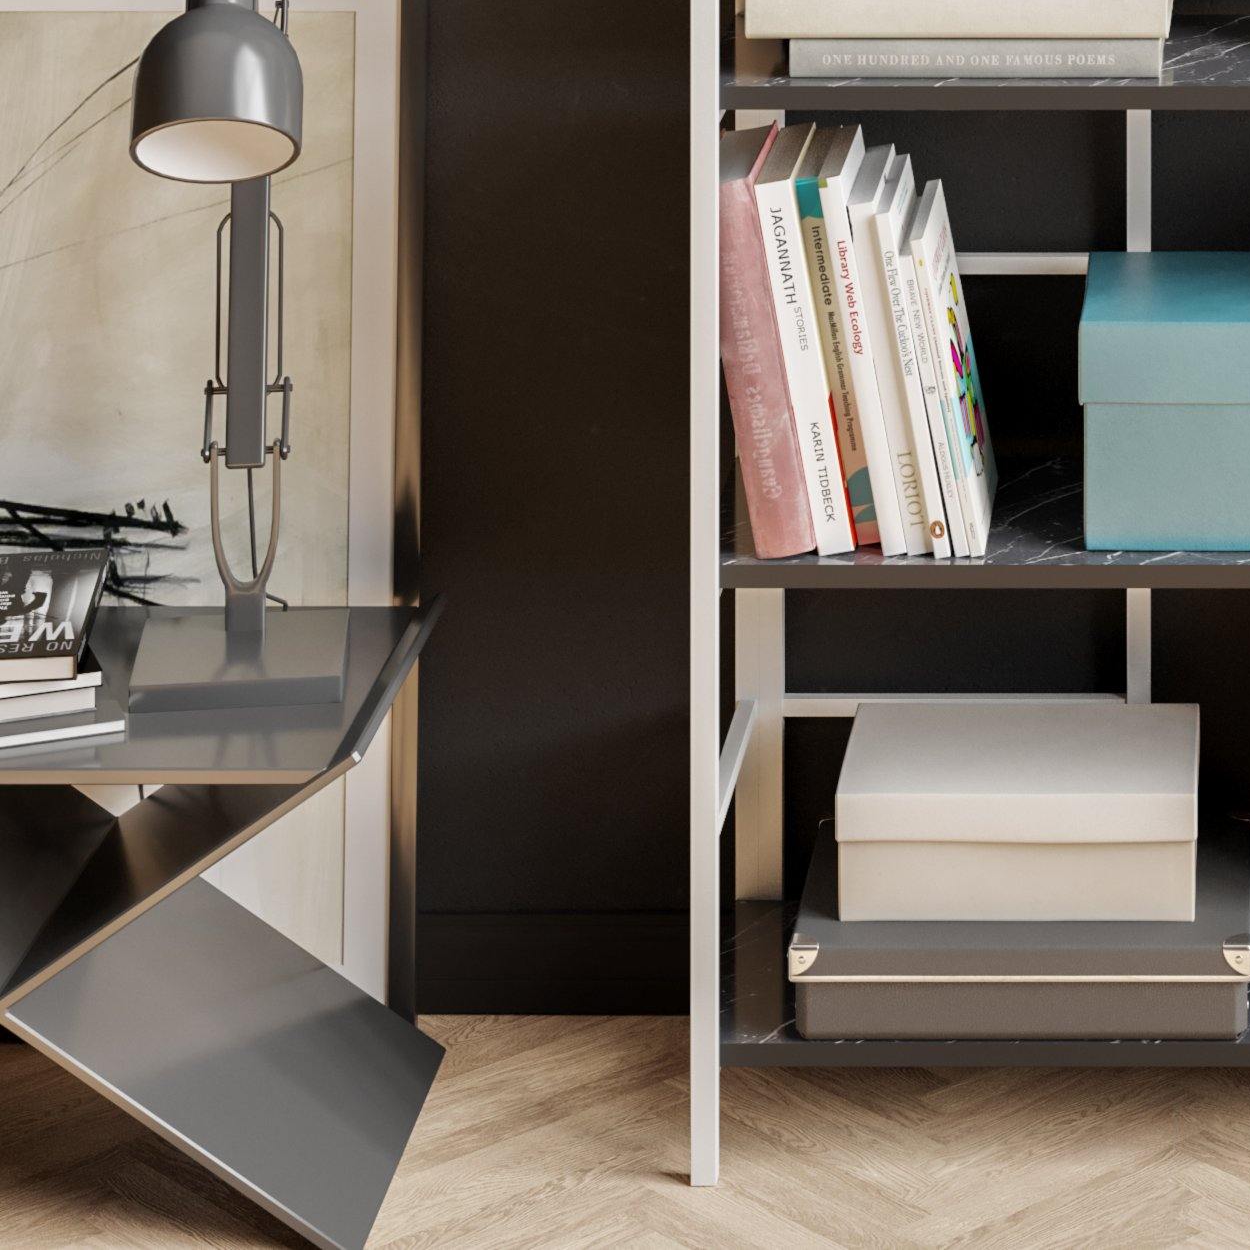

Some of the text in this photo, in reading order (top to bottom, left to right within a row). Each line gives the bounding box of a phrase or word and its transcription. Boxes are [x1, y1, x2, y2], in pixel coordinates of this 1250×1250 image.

[822, 54, 1116, 66] ONE HUNDRED AND ONE FAMOUS POEMS
[770, 206, 808, 350] JAGANNATH STORIES
[812, 226, 832, 306] Intermediate
[837, 240, 864, 355] Library Web Ecology
[884, 251, 914, 376] One Flew Over The Cuckoo's Nest
[907, 279, 928, 364] BRAVE NEW WORLD
[832, 342, 842, 362] English
[837, 364, 847, 391] Grammar
[842, 392, 852, 417] Teaching
[846, 418, 856, 450] Programme
[810, 422, 836, 522] KARIN TIDBECK
[897, 452, 926, 528] LORIOT
[47, 640, 72, 651] NO
